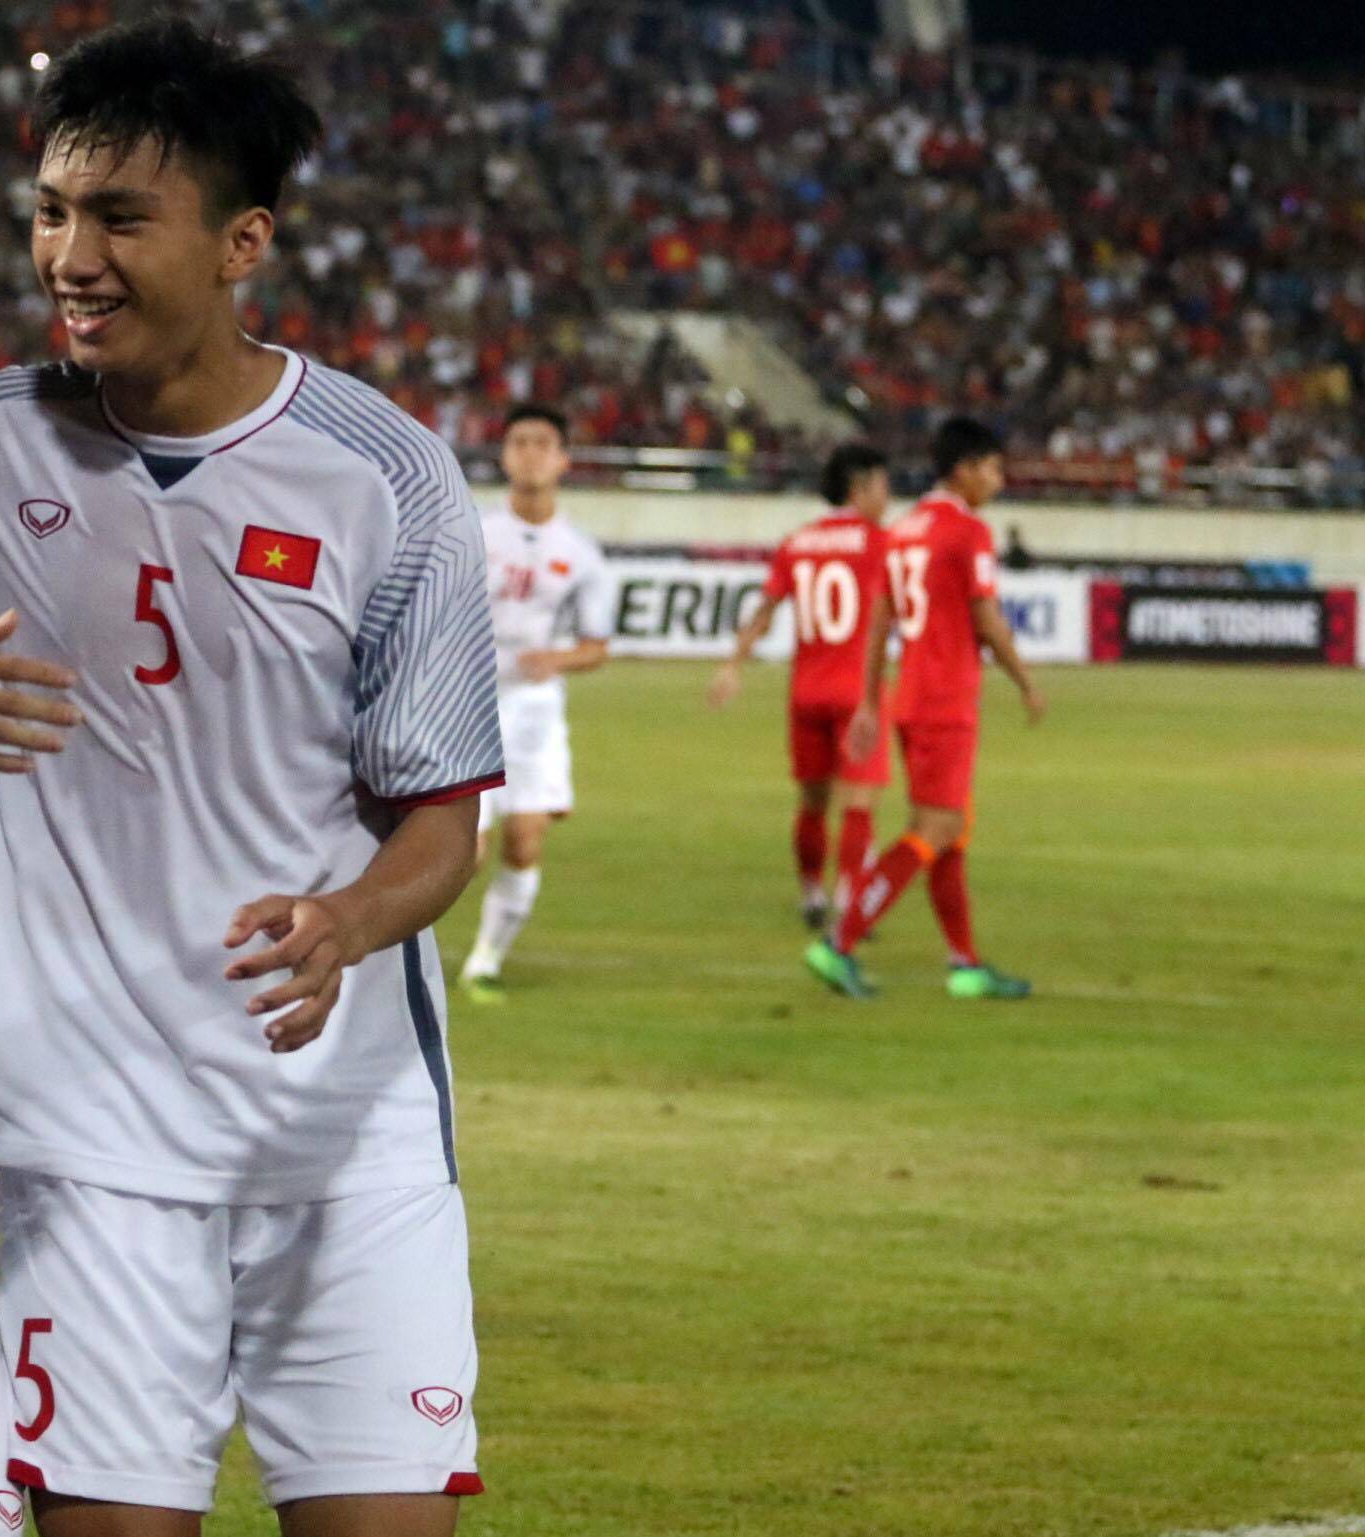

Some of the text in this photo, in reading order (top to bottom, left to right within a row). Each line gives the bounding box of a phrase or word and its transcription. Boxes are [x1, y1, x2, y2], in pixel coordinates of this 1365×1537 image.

[134, 563, 181, 685] 5
[793, 559, 859, 643] 10
[14, 1318, 55, 1441] 5
